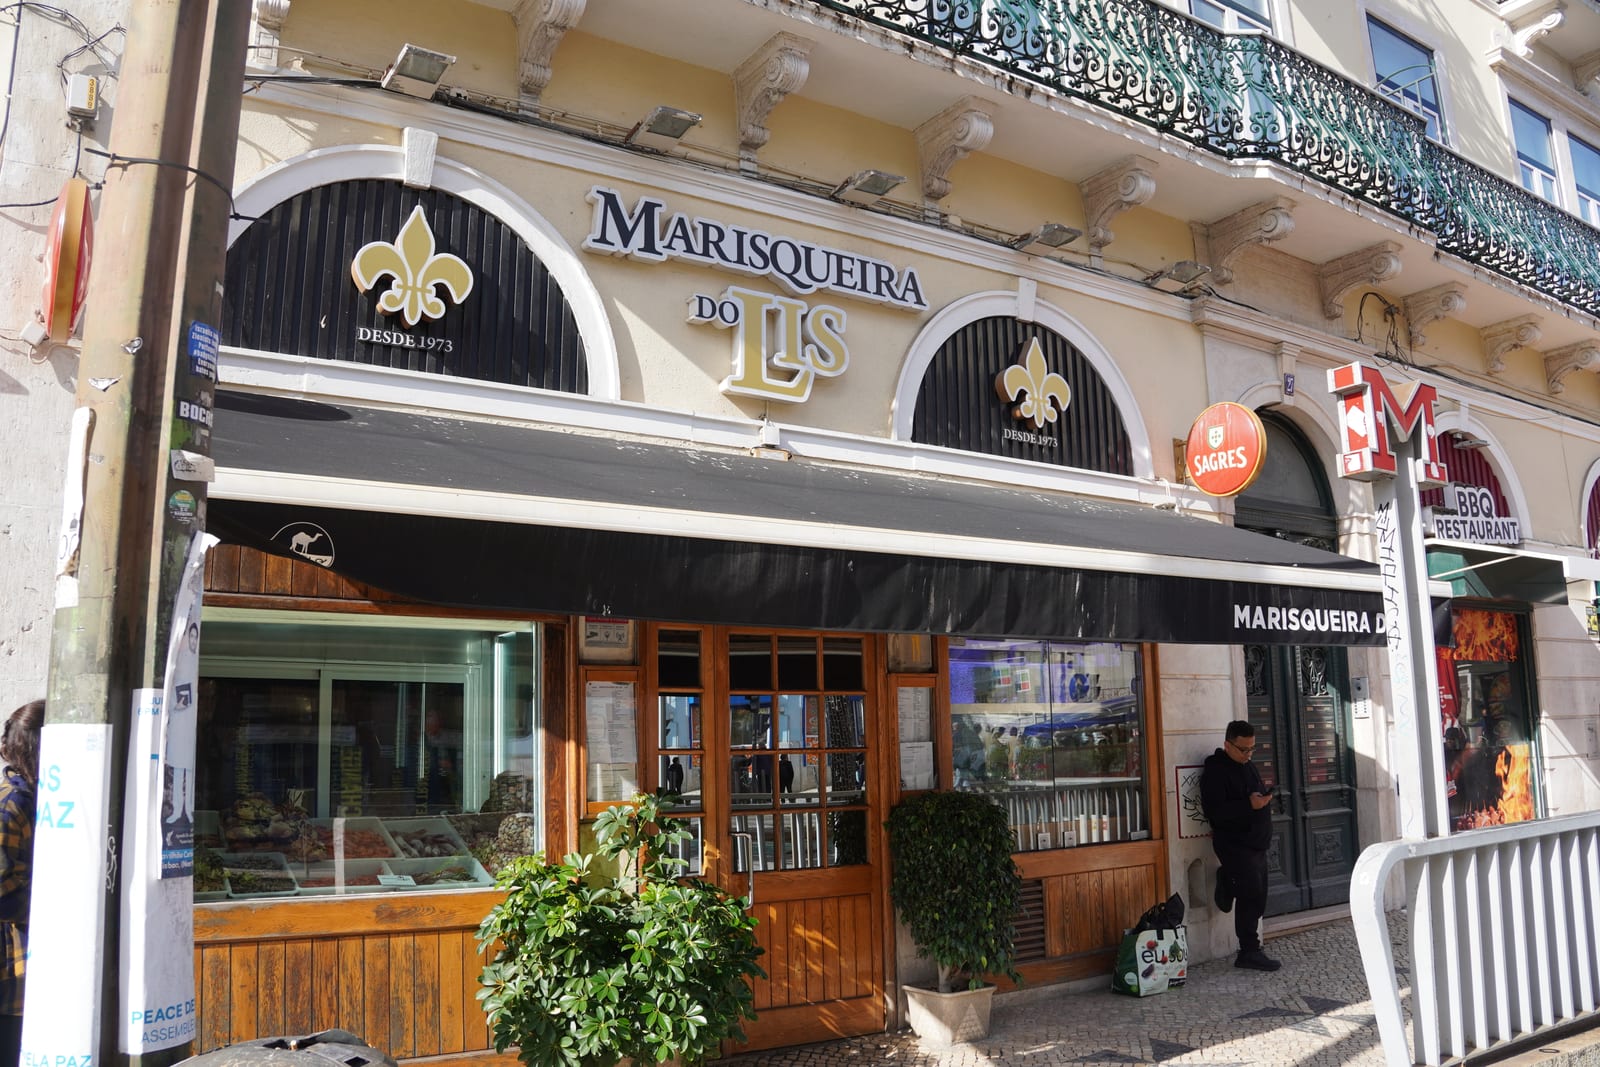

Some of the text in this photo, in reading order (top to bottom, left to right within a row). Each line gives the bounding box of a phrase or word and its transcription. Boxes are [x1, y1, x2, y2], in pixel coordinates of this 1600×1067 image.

[592, 190, 927, 307] MARISQUEIRA
[695, 295, 739, 324] DO
[358, 327, 454, 353] DESDE 1973
[731, 291, 846, 398] LIS
[1004, 428, 1058, 447] DESDE 1973
[1357, 362, 1449, 486] M
[1194, 446, 1248, 477] SAGRES
[1457, 490, 1494, 519] BBQ
[1436, 519, 1518, 541] RESTAURANT
[1234, 604, 1371, 634] MARISQUEIRA
[131, 1004, 183, 1025] PEACE
